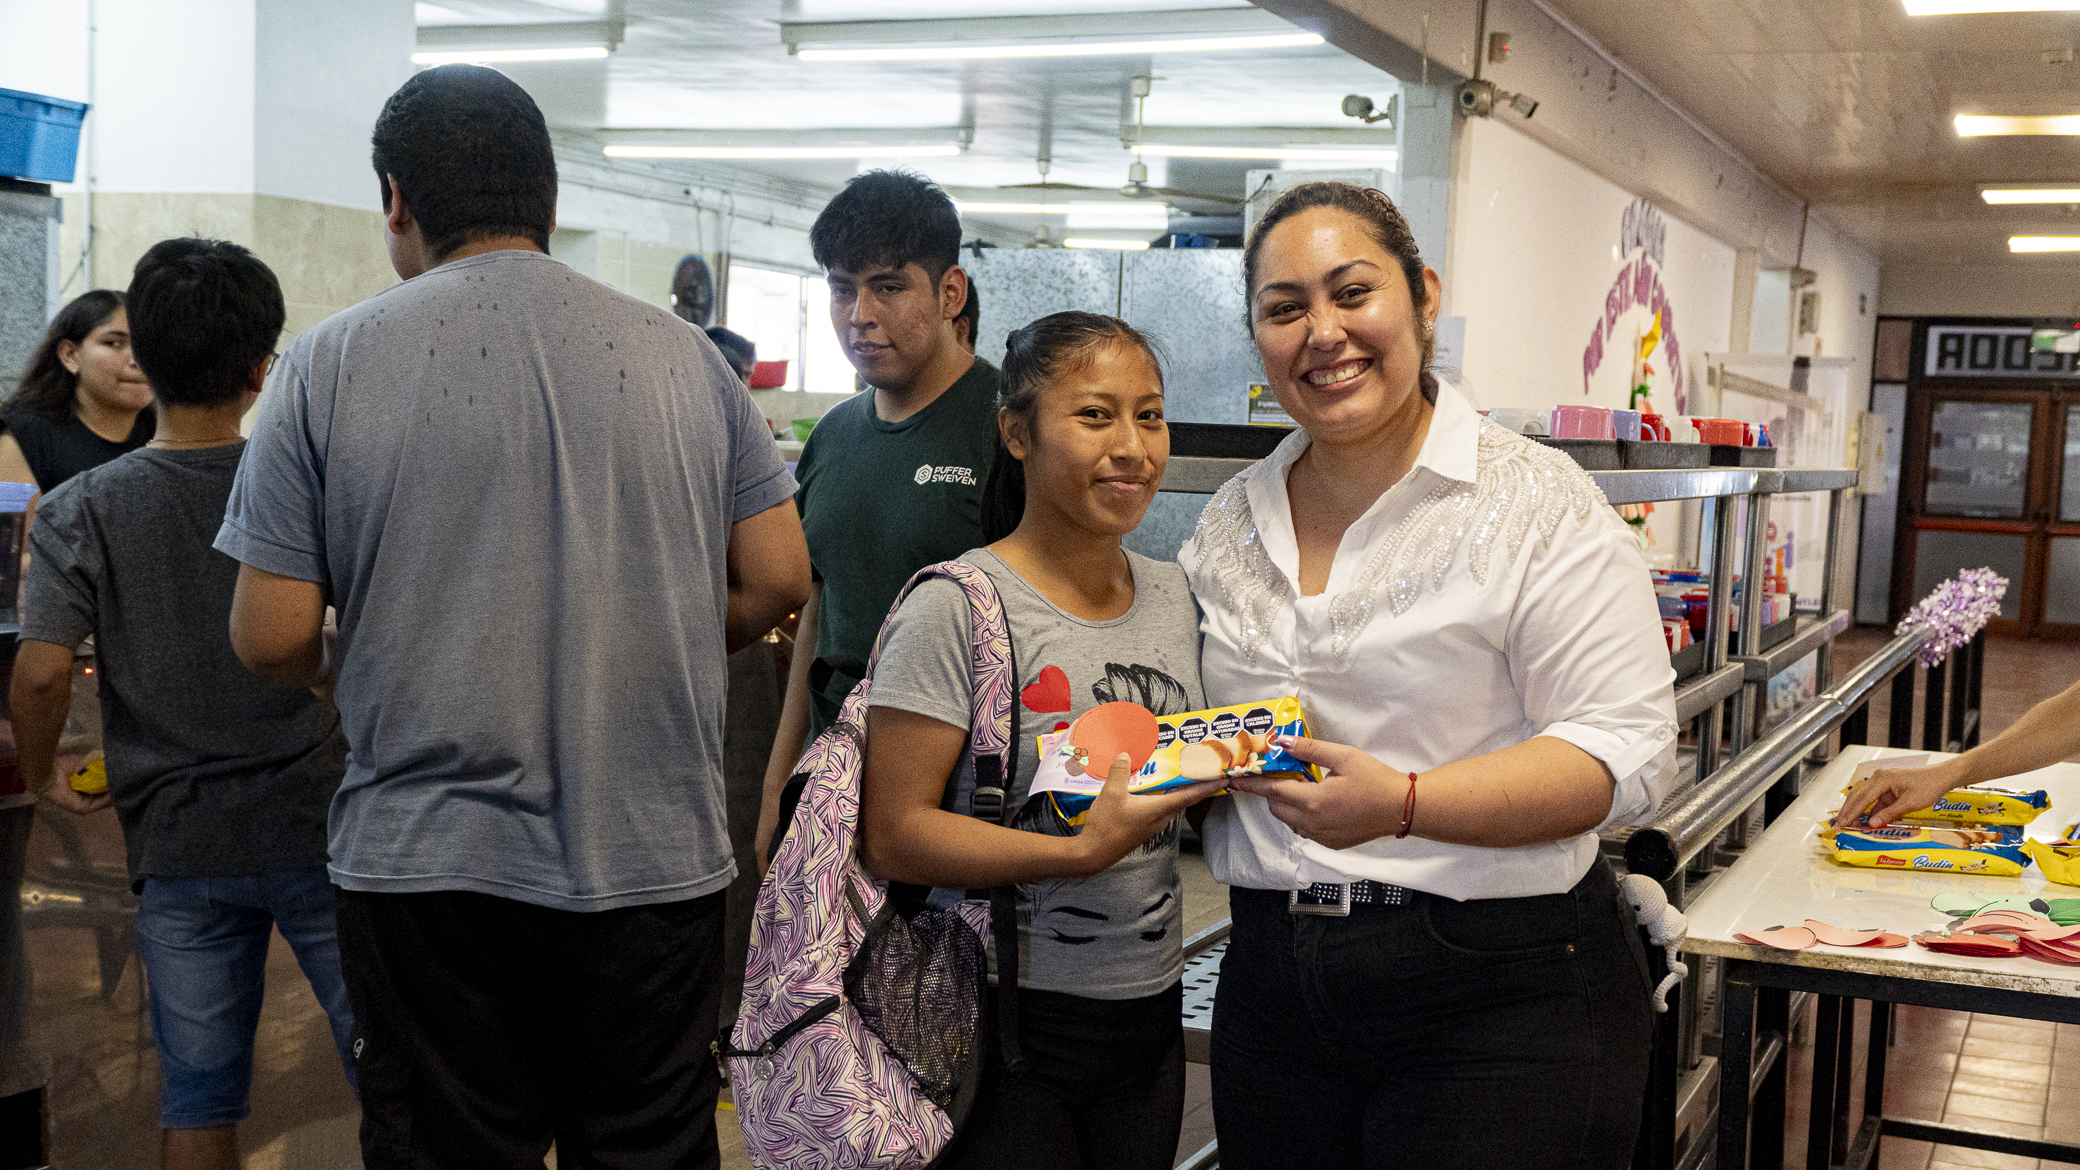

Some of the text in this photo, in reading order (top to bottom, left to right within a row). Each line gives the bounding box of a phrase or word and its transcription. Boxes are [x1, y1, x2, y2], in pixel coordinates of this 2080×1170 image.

[933, 466, 972, 477] PUFFER
[931, 473, 977, 486] SWEIVEN
[1182, 731, 1205, 739] TOTALES
[1211, 726, 1241, 735] SATURADAS
[1912, 854, 1955, 869] Budín
